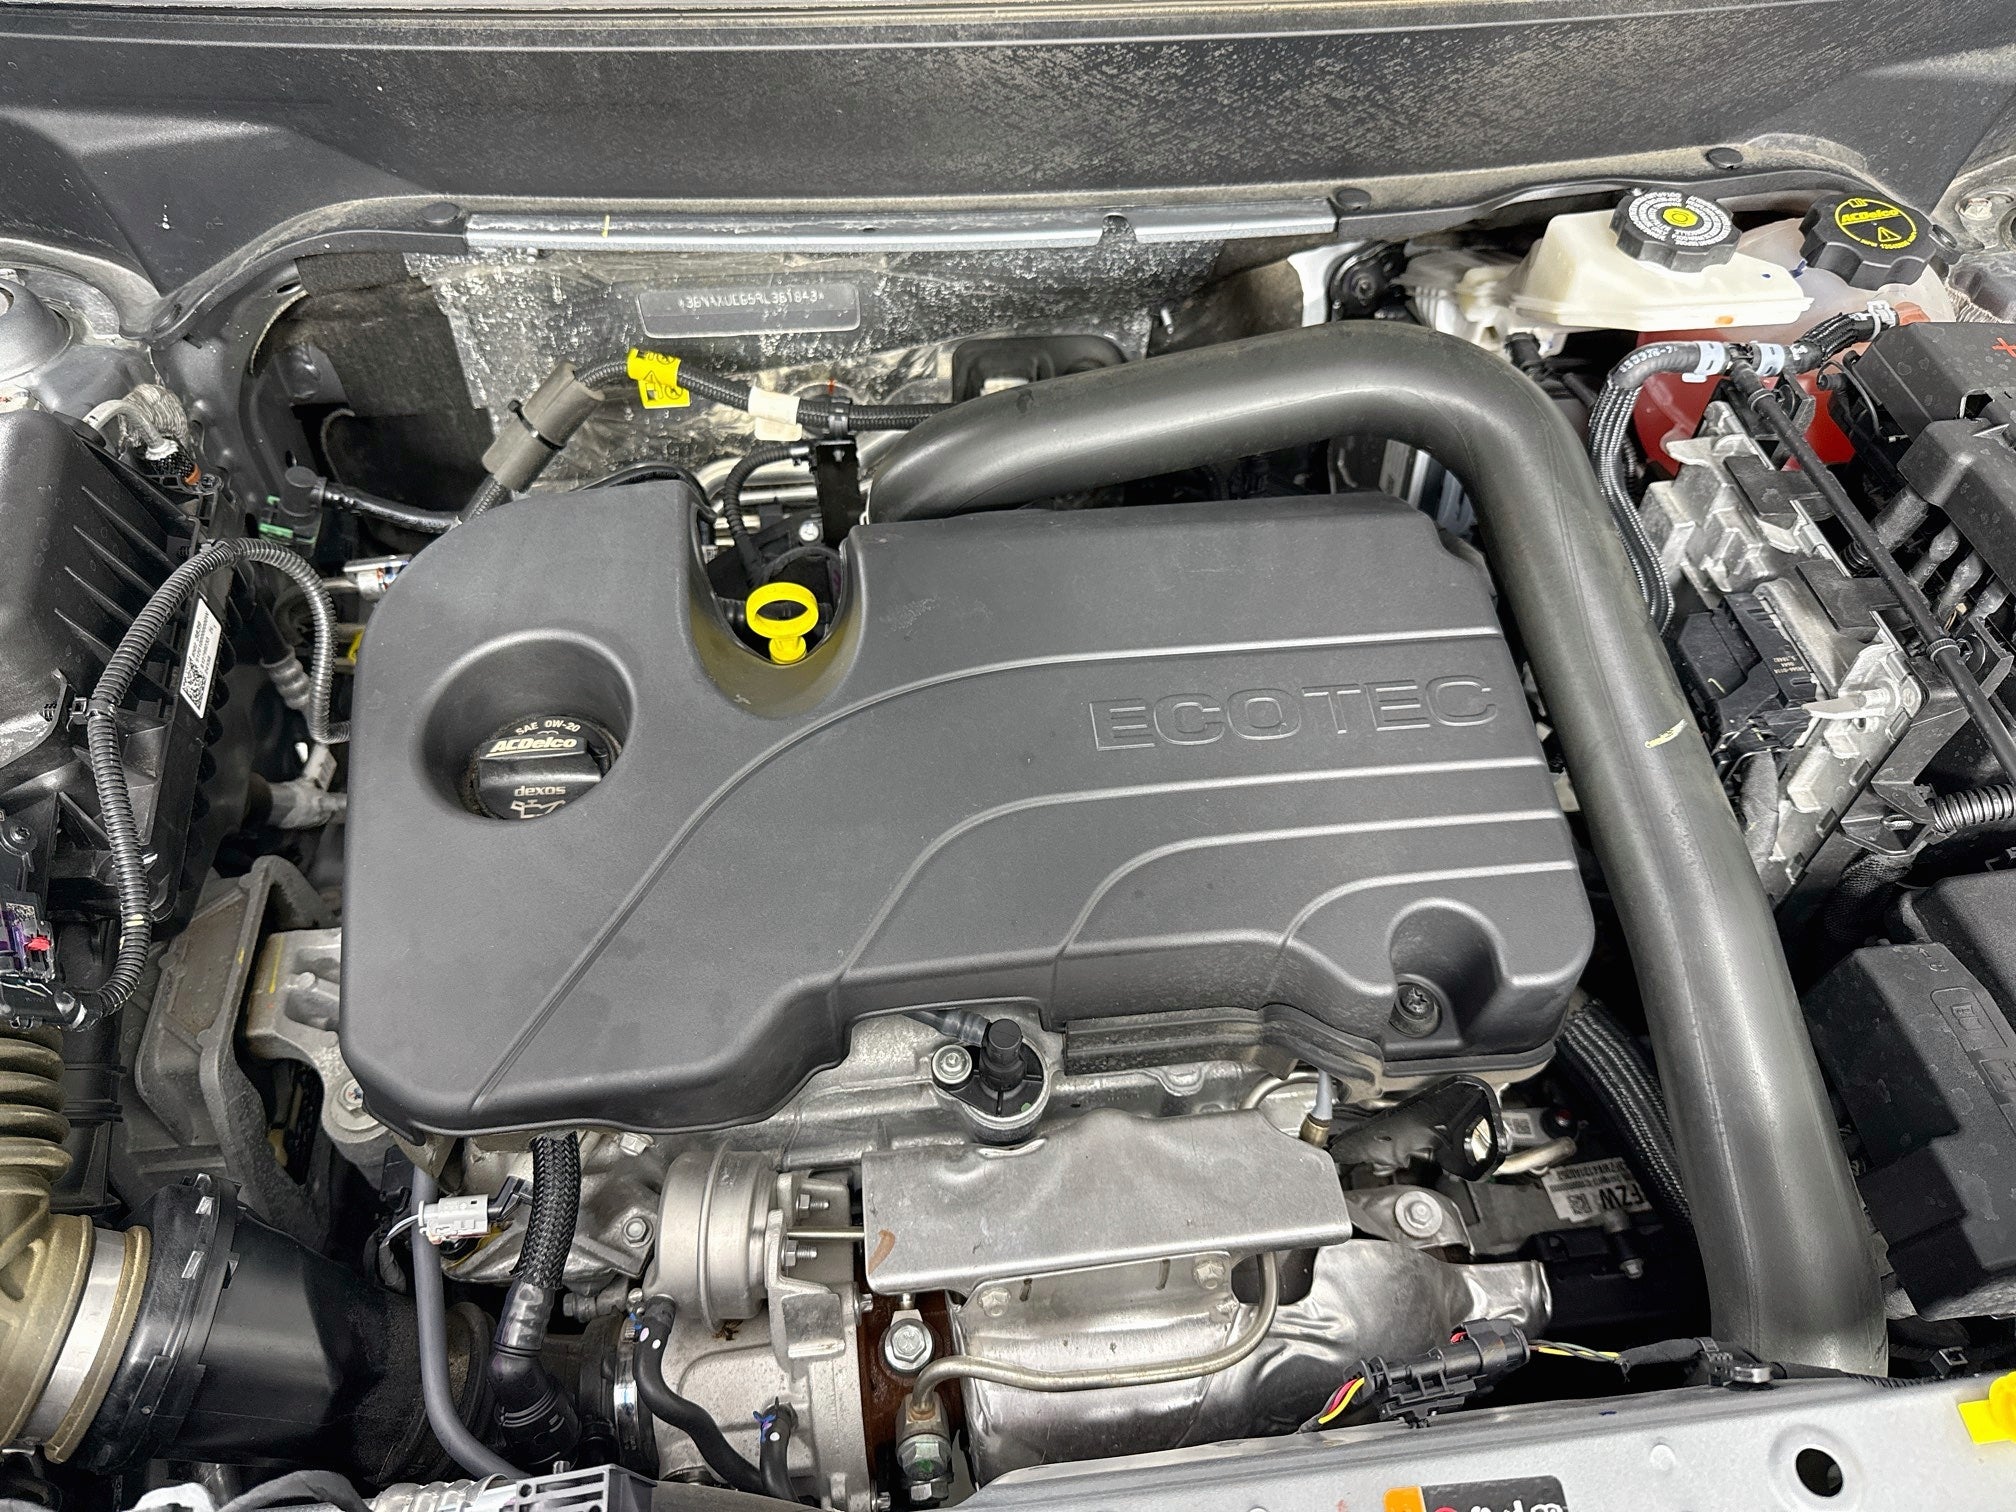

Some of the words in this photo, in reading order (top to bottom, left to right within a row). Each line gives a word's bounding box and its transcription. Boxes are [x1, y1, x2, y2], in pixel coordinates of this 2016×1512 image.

[1089, 674, 1498, 751] ECOTEC
[515, 722, 538, 735] SAE
[544, 719, 581, 733] 0W-20
[490, 736, 578, 753] ACDelco
[514, 785, 566, 797] dexos
